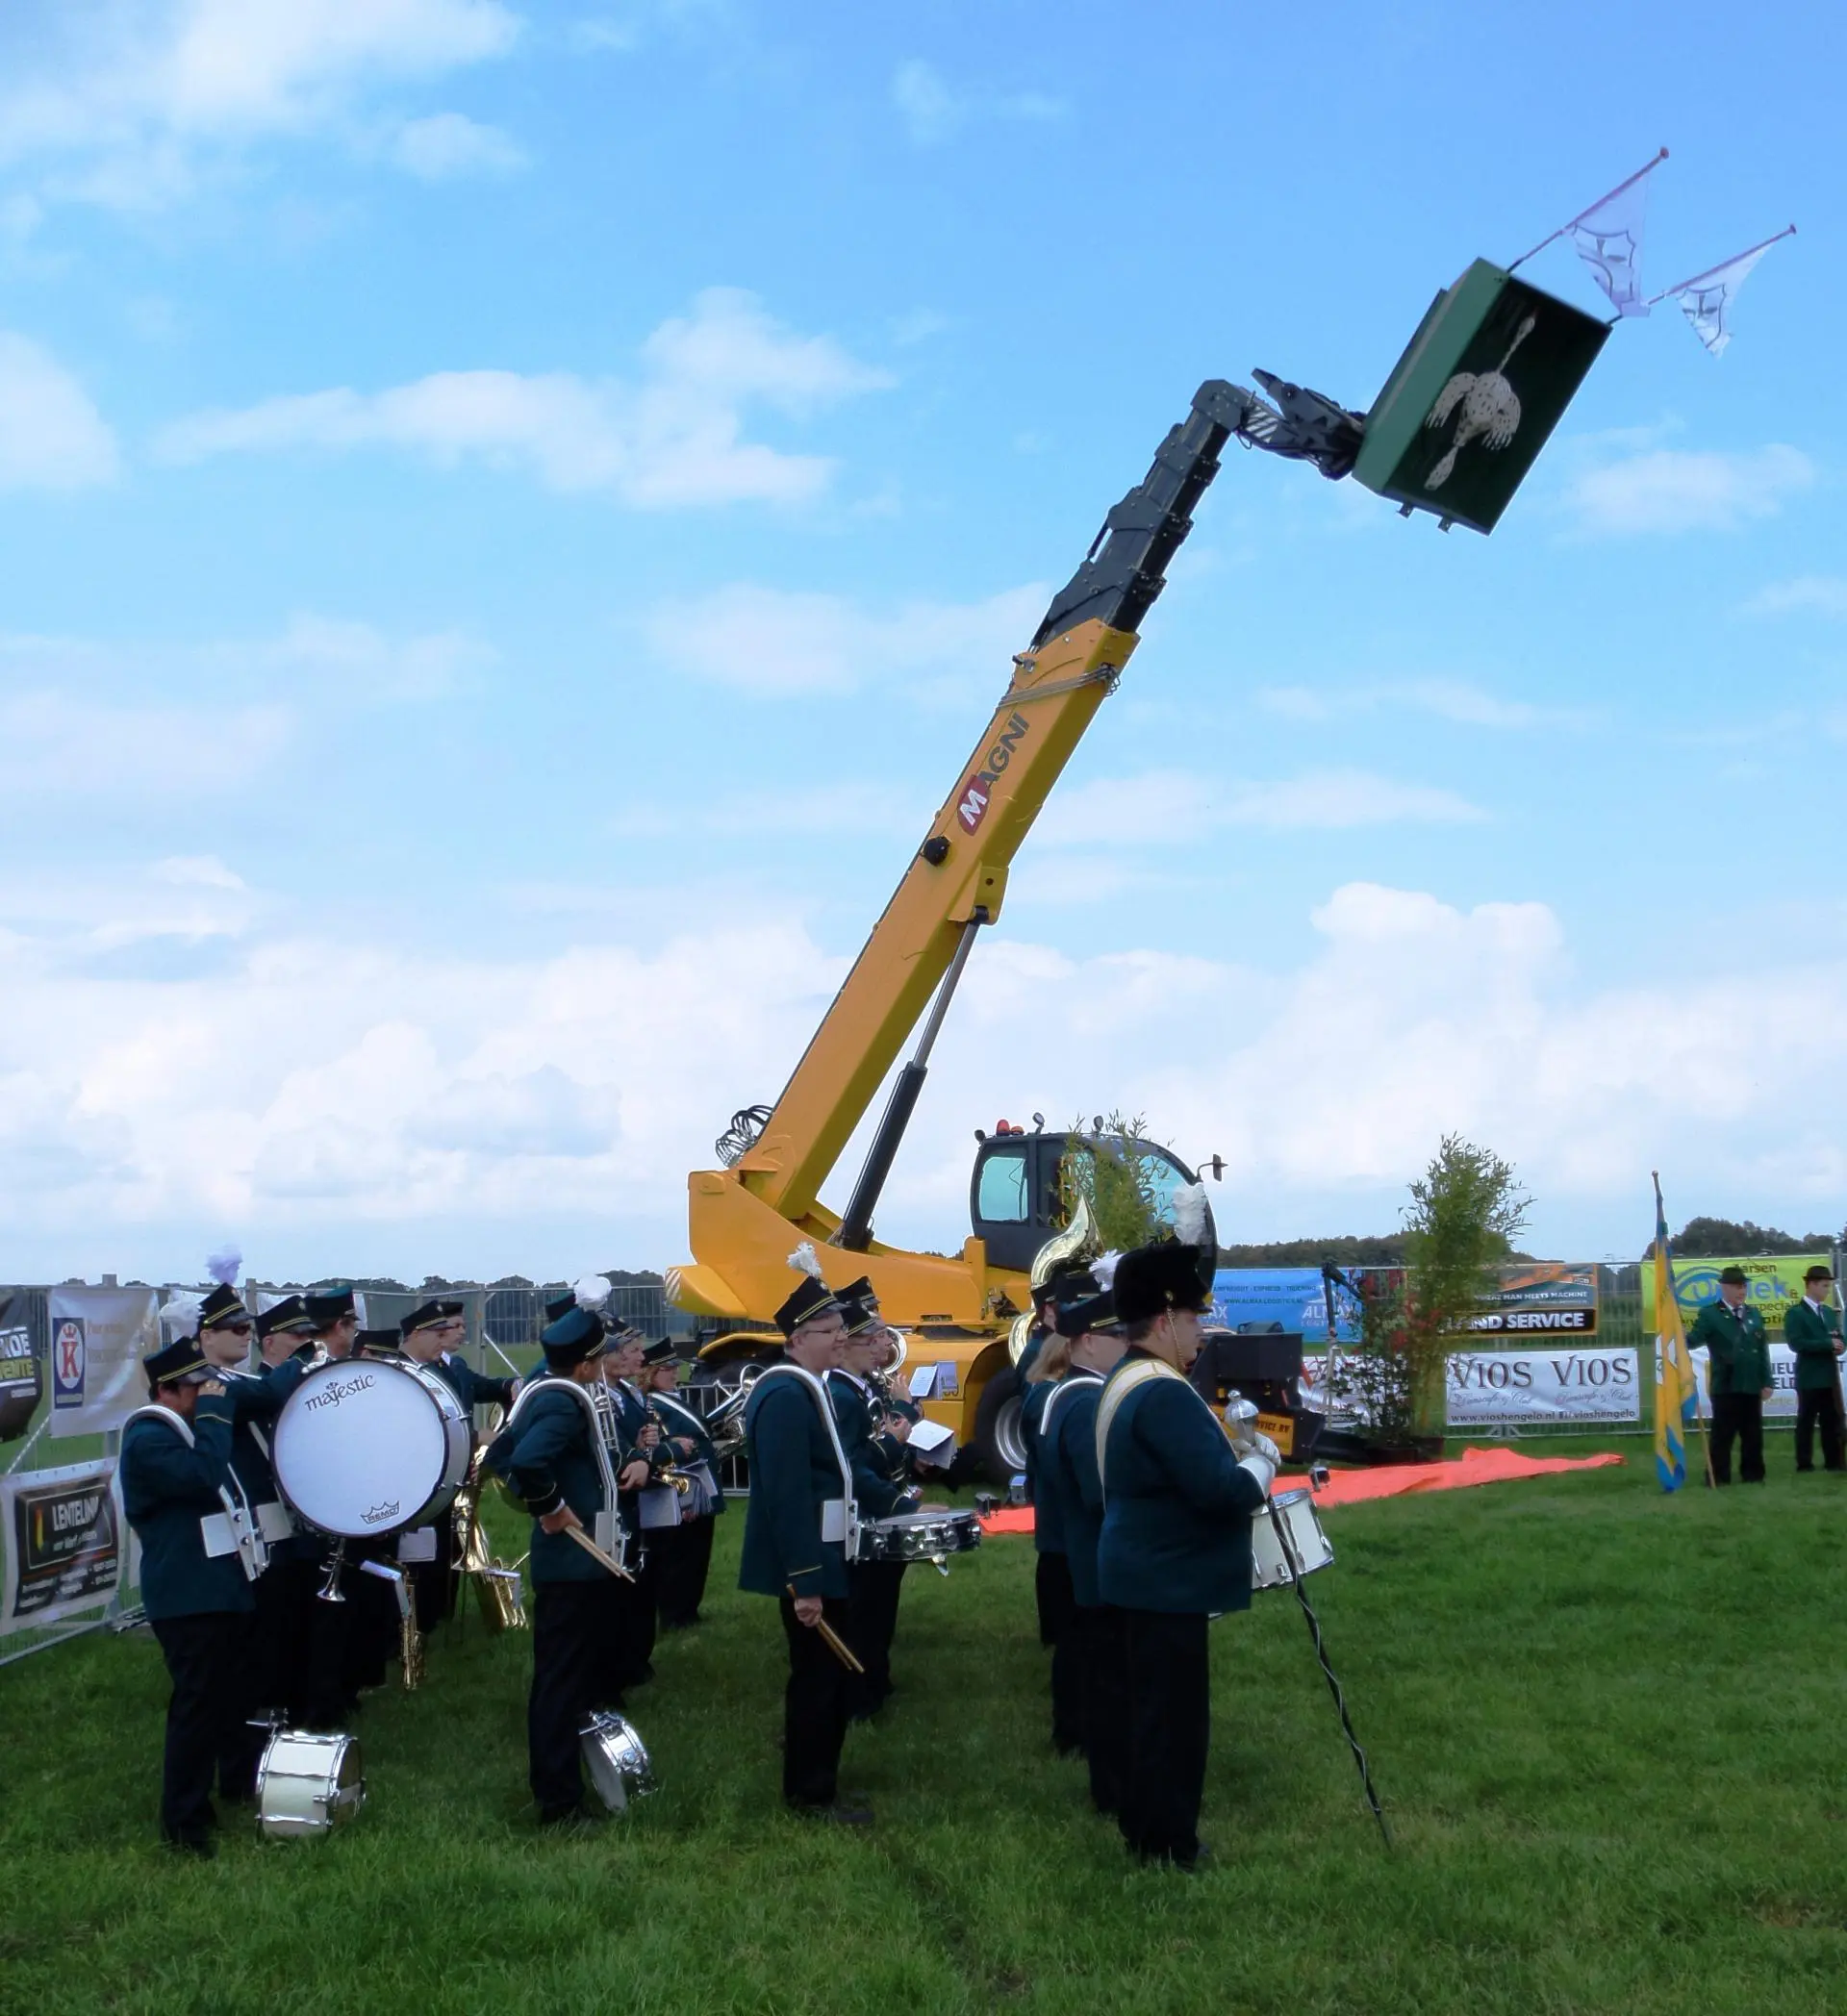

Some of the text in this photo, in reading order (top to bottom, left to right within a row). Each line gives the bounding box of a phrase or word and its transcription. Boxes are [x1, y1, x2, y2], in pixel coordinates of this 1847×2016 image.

[960, 712, 1030, 826] MAGNI
[1734, 1263, 1777, 1273] arsen
[1506, 1313, 1585, 1329] SERVICE
[1451, 1354, 1632, 1389] VIOS VIOS
[305, 1374, 376, 1412] majestic
[1451, 1411, 1556, 1424] www.vioshengelo.nl
